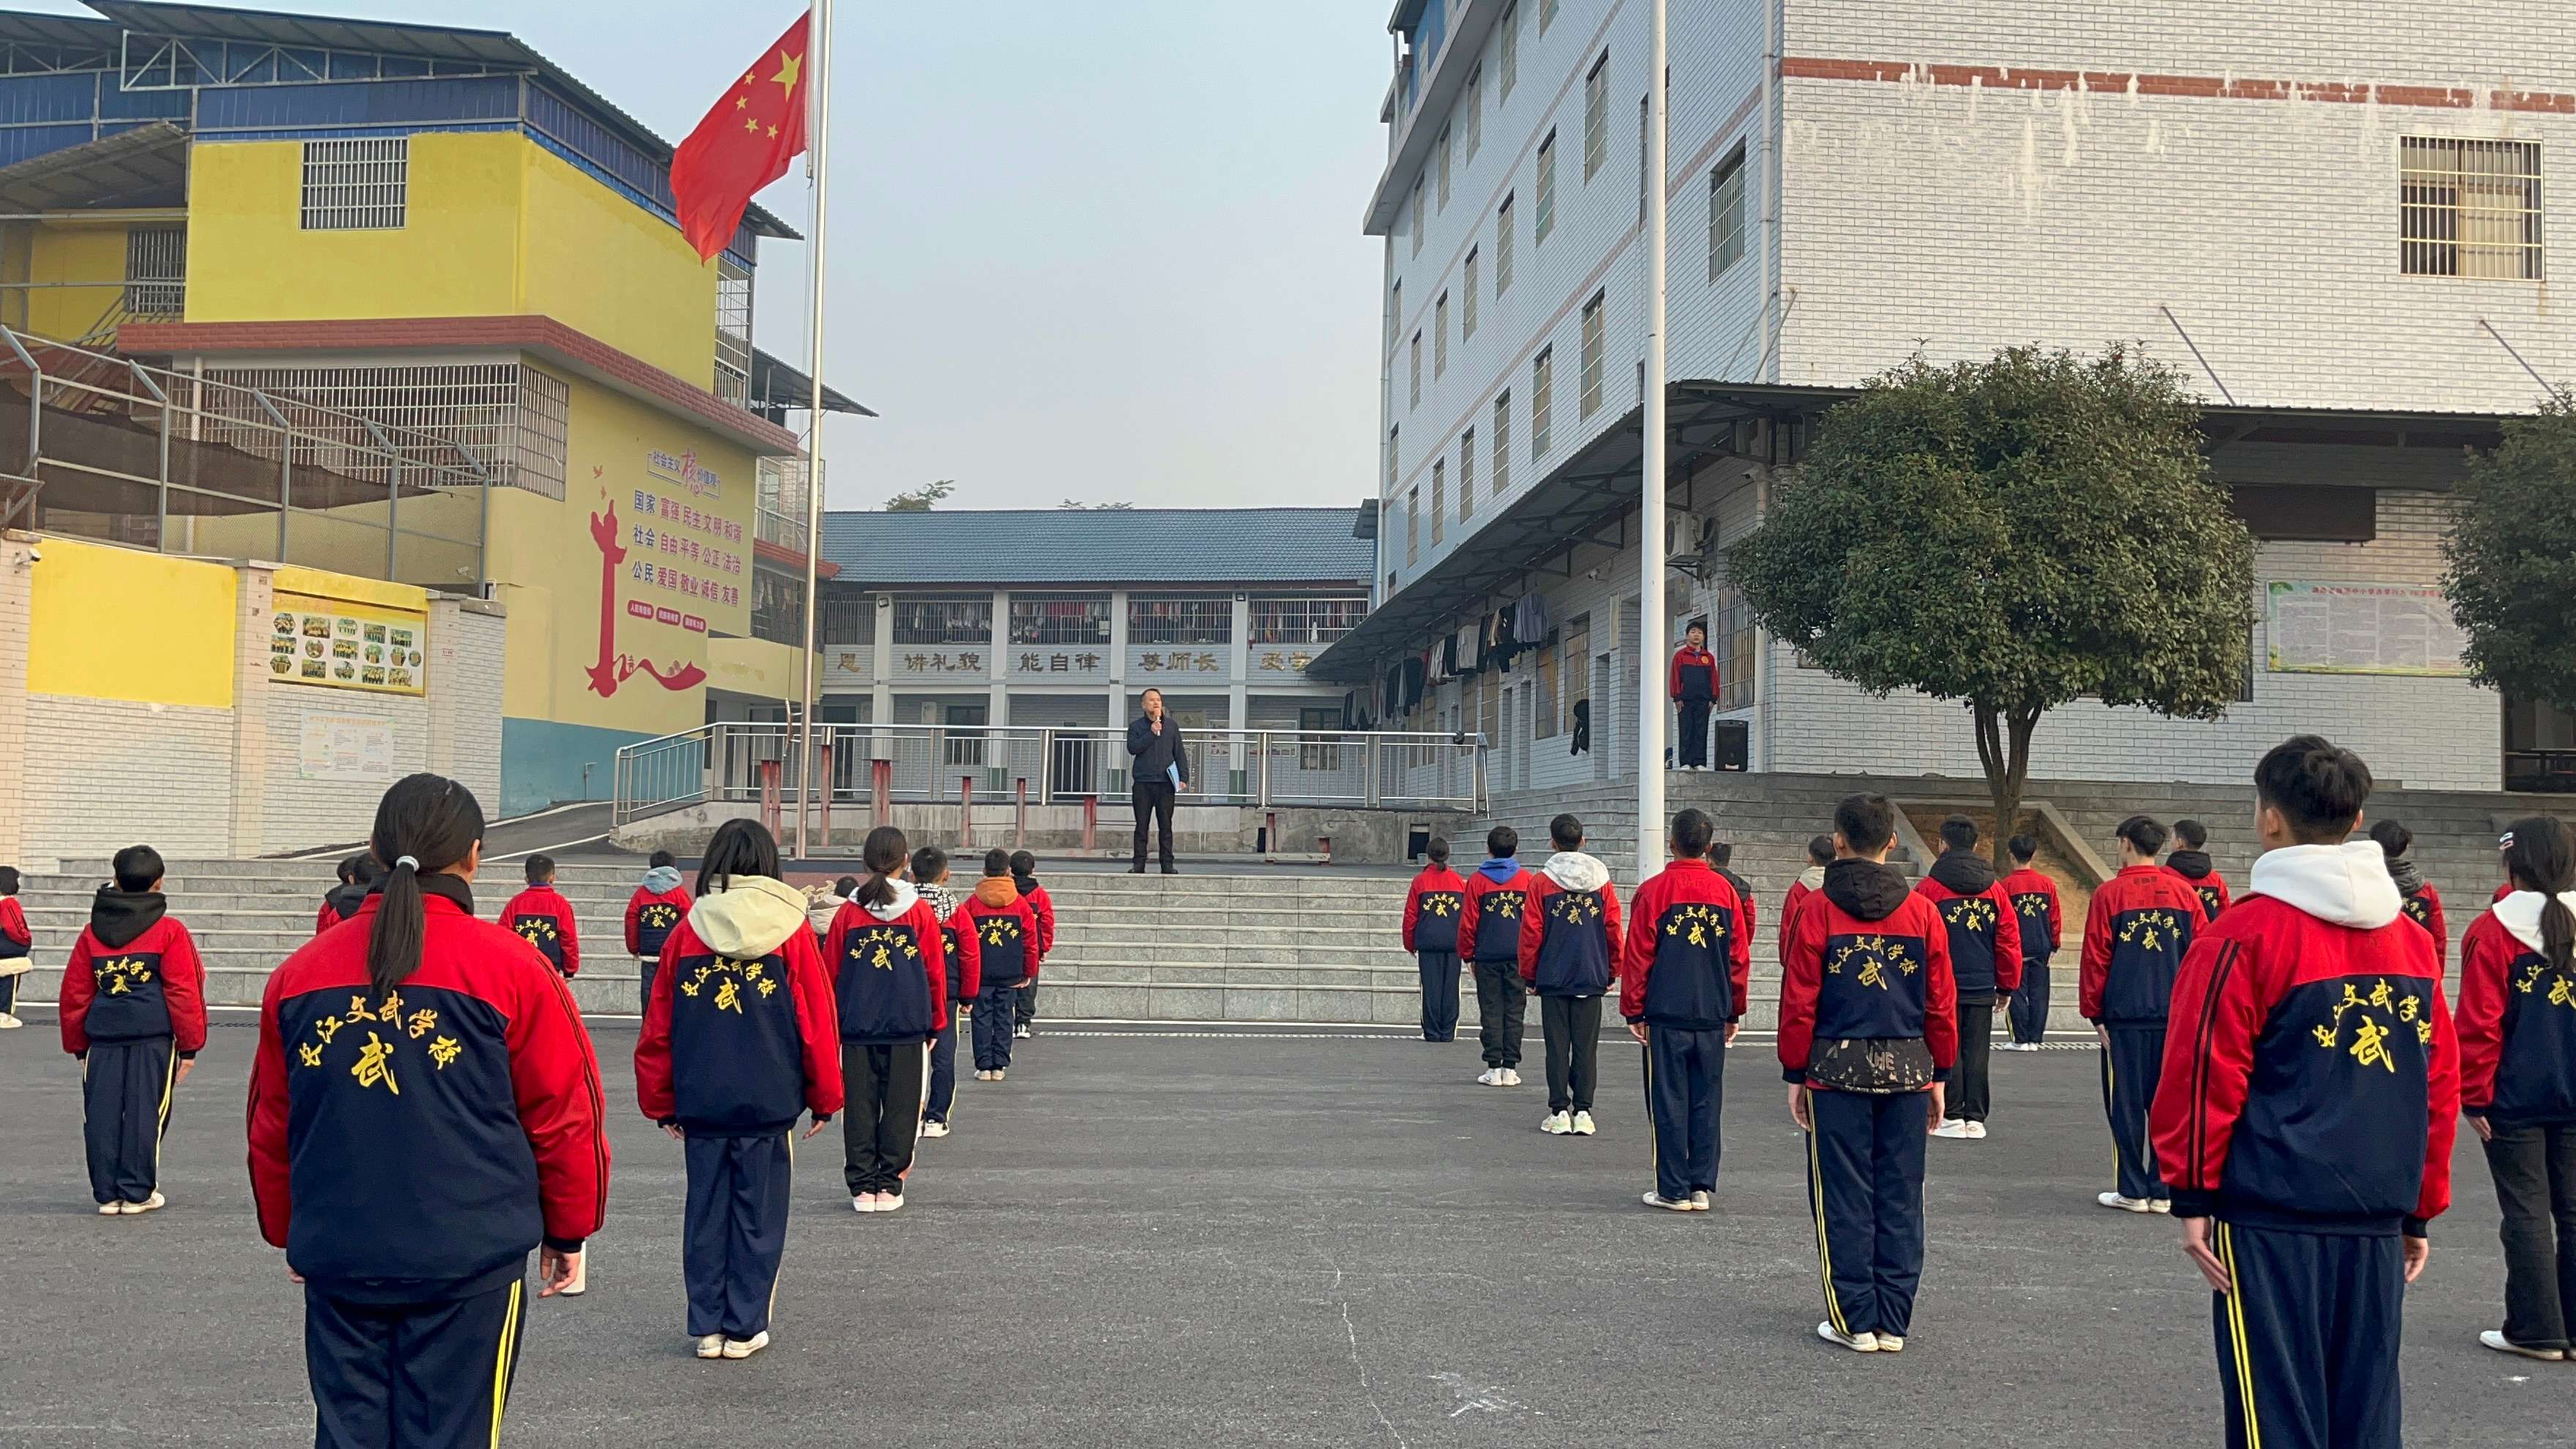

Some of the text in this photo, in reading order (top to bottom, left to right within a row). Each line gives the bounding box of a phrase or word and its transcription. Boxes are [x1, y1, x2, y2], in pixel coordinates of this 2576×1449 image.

[634, 490, 743, 543] 国家 富强 民主 文明 和谐
[634, 524, 741, 573] 社会 自由 平等 公正 法治
[632, 561, 739, 606] 公民 爱国 敬业 诚信 友善
[904, 651, 981, 673] 讲礼貌
[1018, 651, 1101, 672] 能自律
[1138, 651, 1220, 672] 尊师长
[652, 914, 665, 928] 武
[1435, 902, 1448, 917] 武
[1501, 902, 1516, 919] 武
[1568, 905, 1583, 925] 武
[1966, 911, 1982, 932] 武
[2023, 902, 2036, 917] 武
[988, 929, 1003, 947] 武
[1688, 921, 1707, 948] 武
[2142, 926, 2163, 952] 武
[872, 944, 893, 971] 武
[1857, 955, 1888, 991] 武
[714, 976, 743, 1014] 武
[2547, 974, 2576, 1010] 武
[2349, 1014, 2395, 1074] 武
[351, 1030, 400, 1096] 武
